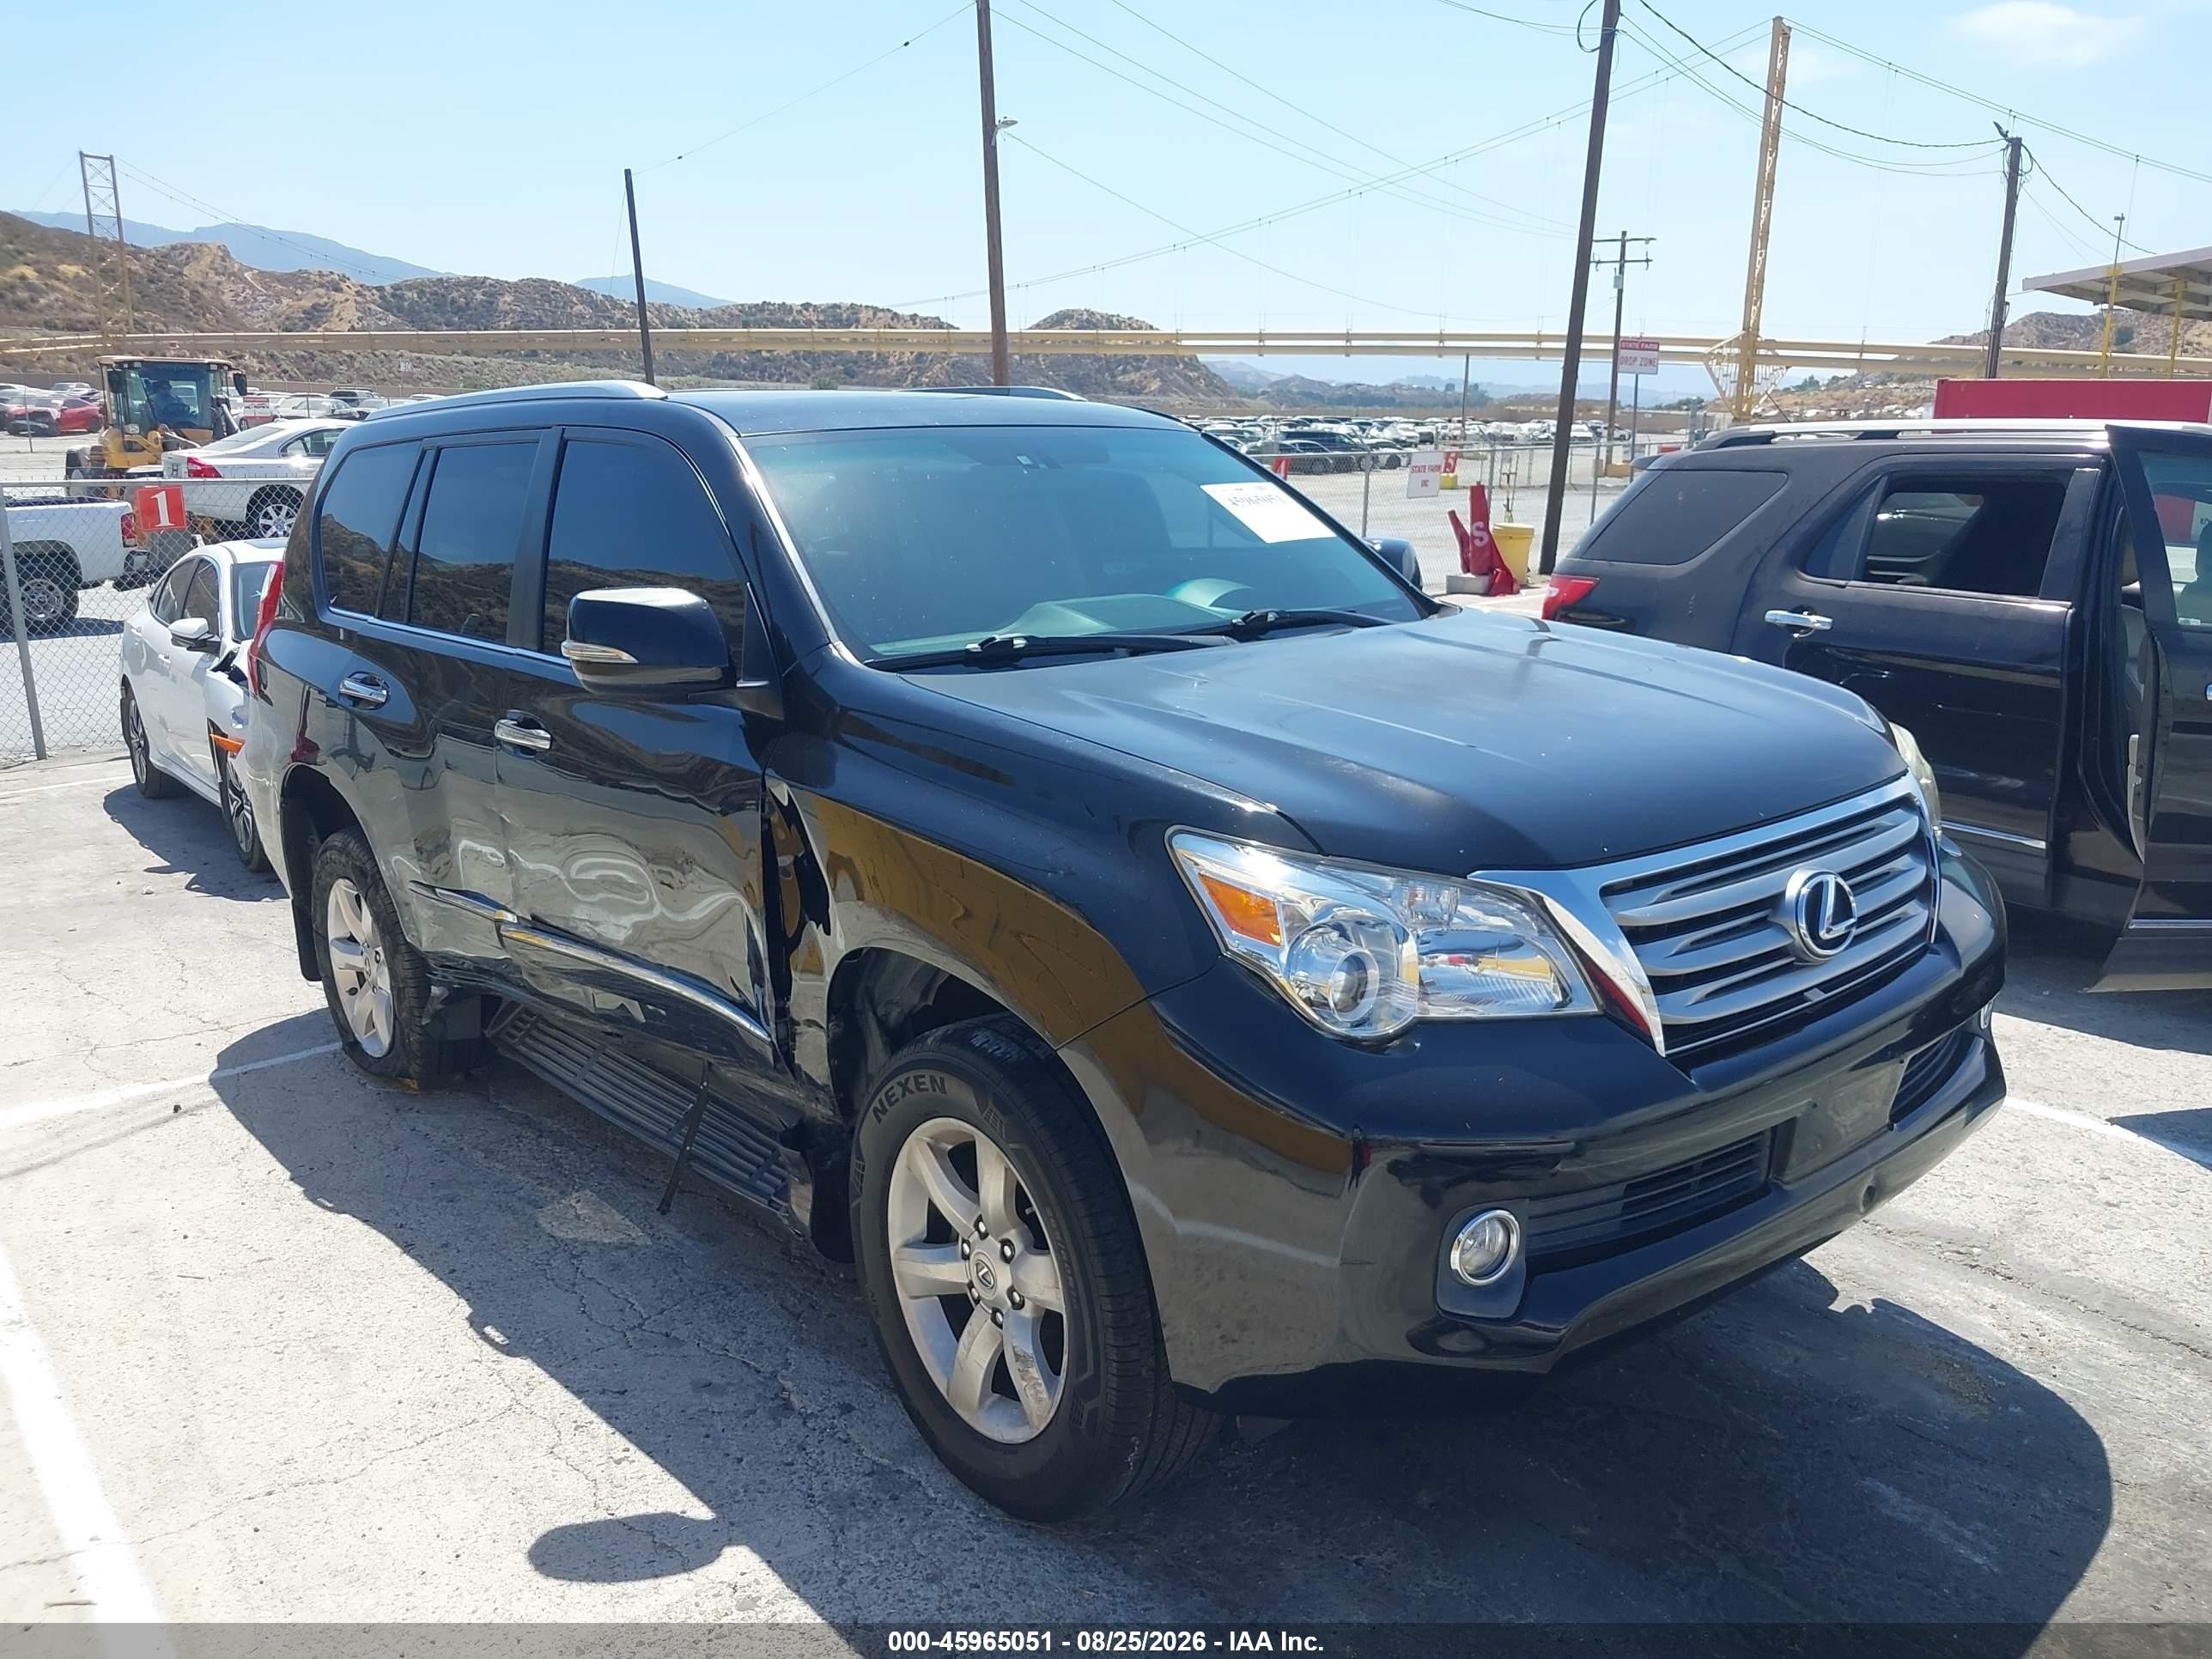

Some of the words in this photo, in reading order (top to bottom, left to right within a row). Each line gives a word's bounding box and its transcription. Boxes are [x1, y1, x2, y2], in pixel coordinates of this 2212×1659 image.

[1620, 356, 1637, 366] DROP
[1639, 356, 1656, 368] ZONE
[1411, 465, 1427, 474] STATE
[1428, 464, 1443, 472] FARM
[150, 490, 175, 527] 1
[1473, 520, 1488, 546] S
[872, 1074, 947, 1124] NEXEN
